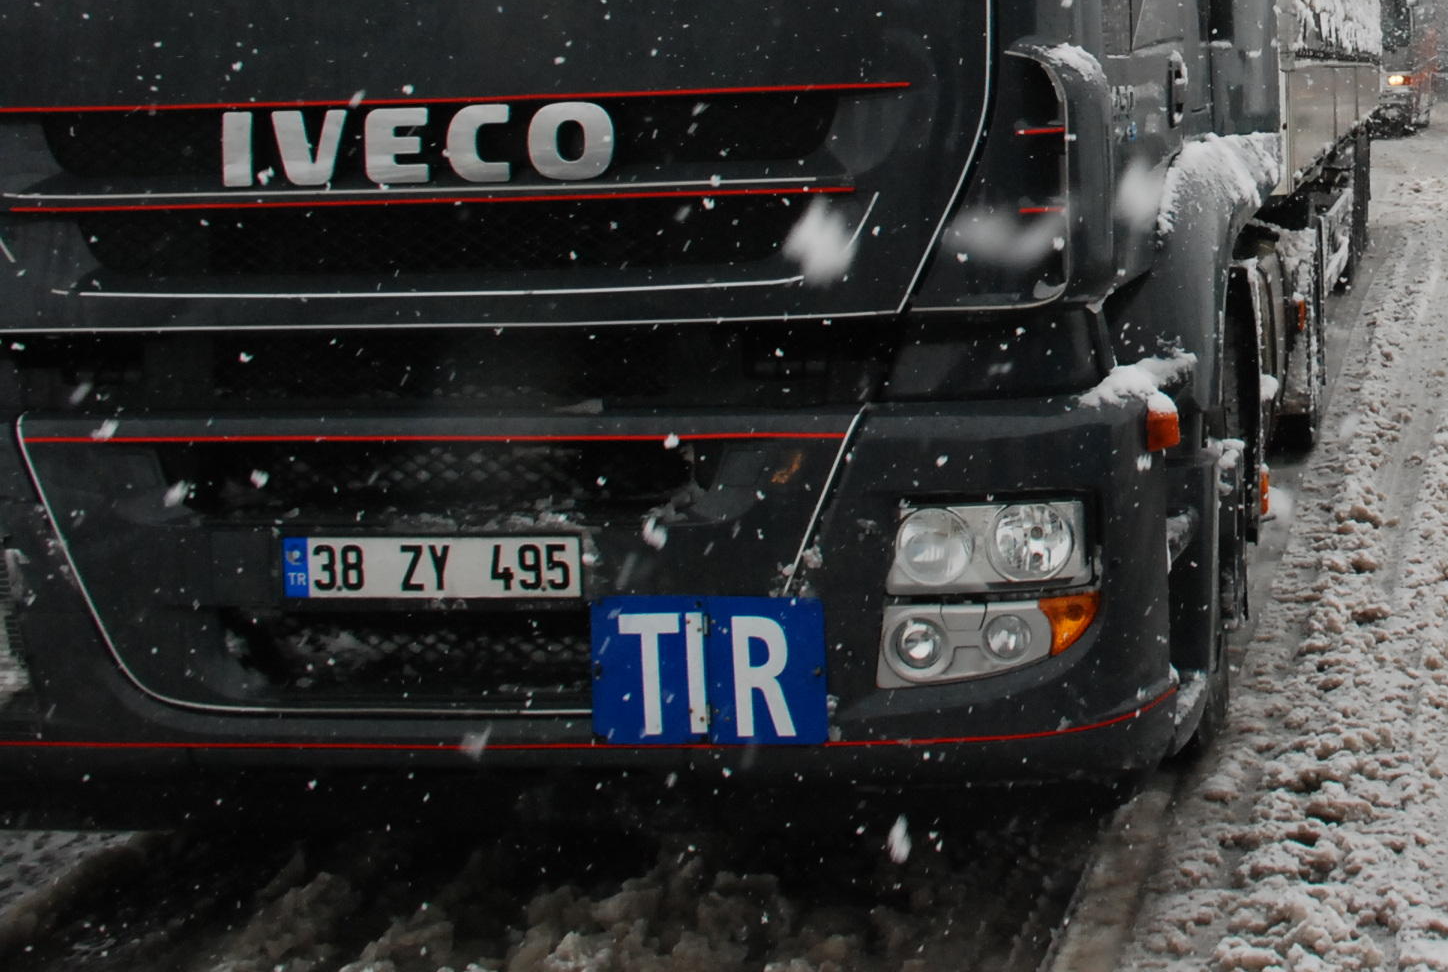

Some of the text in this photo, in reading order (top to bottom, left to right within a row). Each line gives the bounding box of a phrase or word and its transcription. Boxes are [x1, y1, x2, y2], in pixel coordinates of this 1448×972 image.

[222, 101, 614, 187] IVECO
[288, 572, 307, 586] TR
[312, 543, 570, 591] 38 ZY 495
[618, 612, 797, 737] TIR
